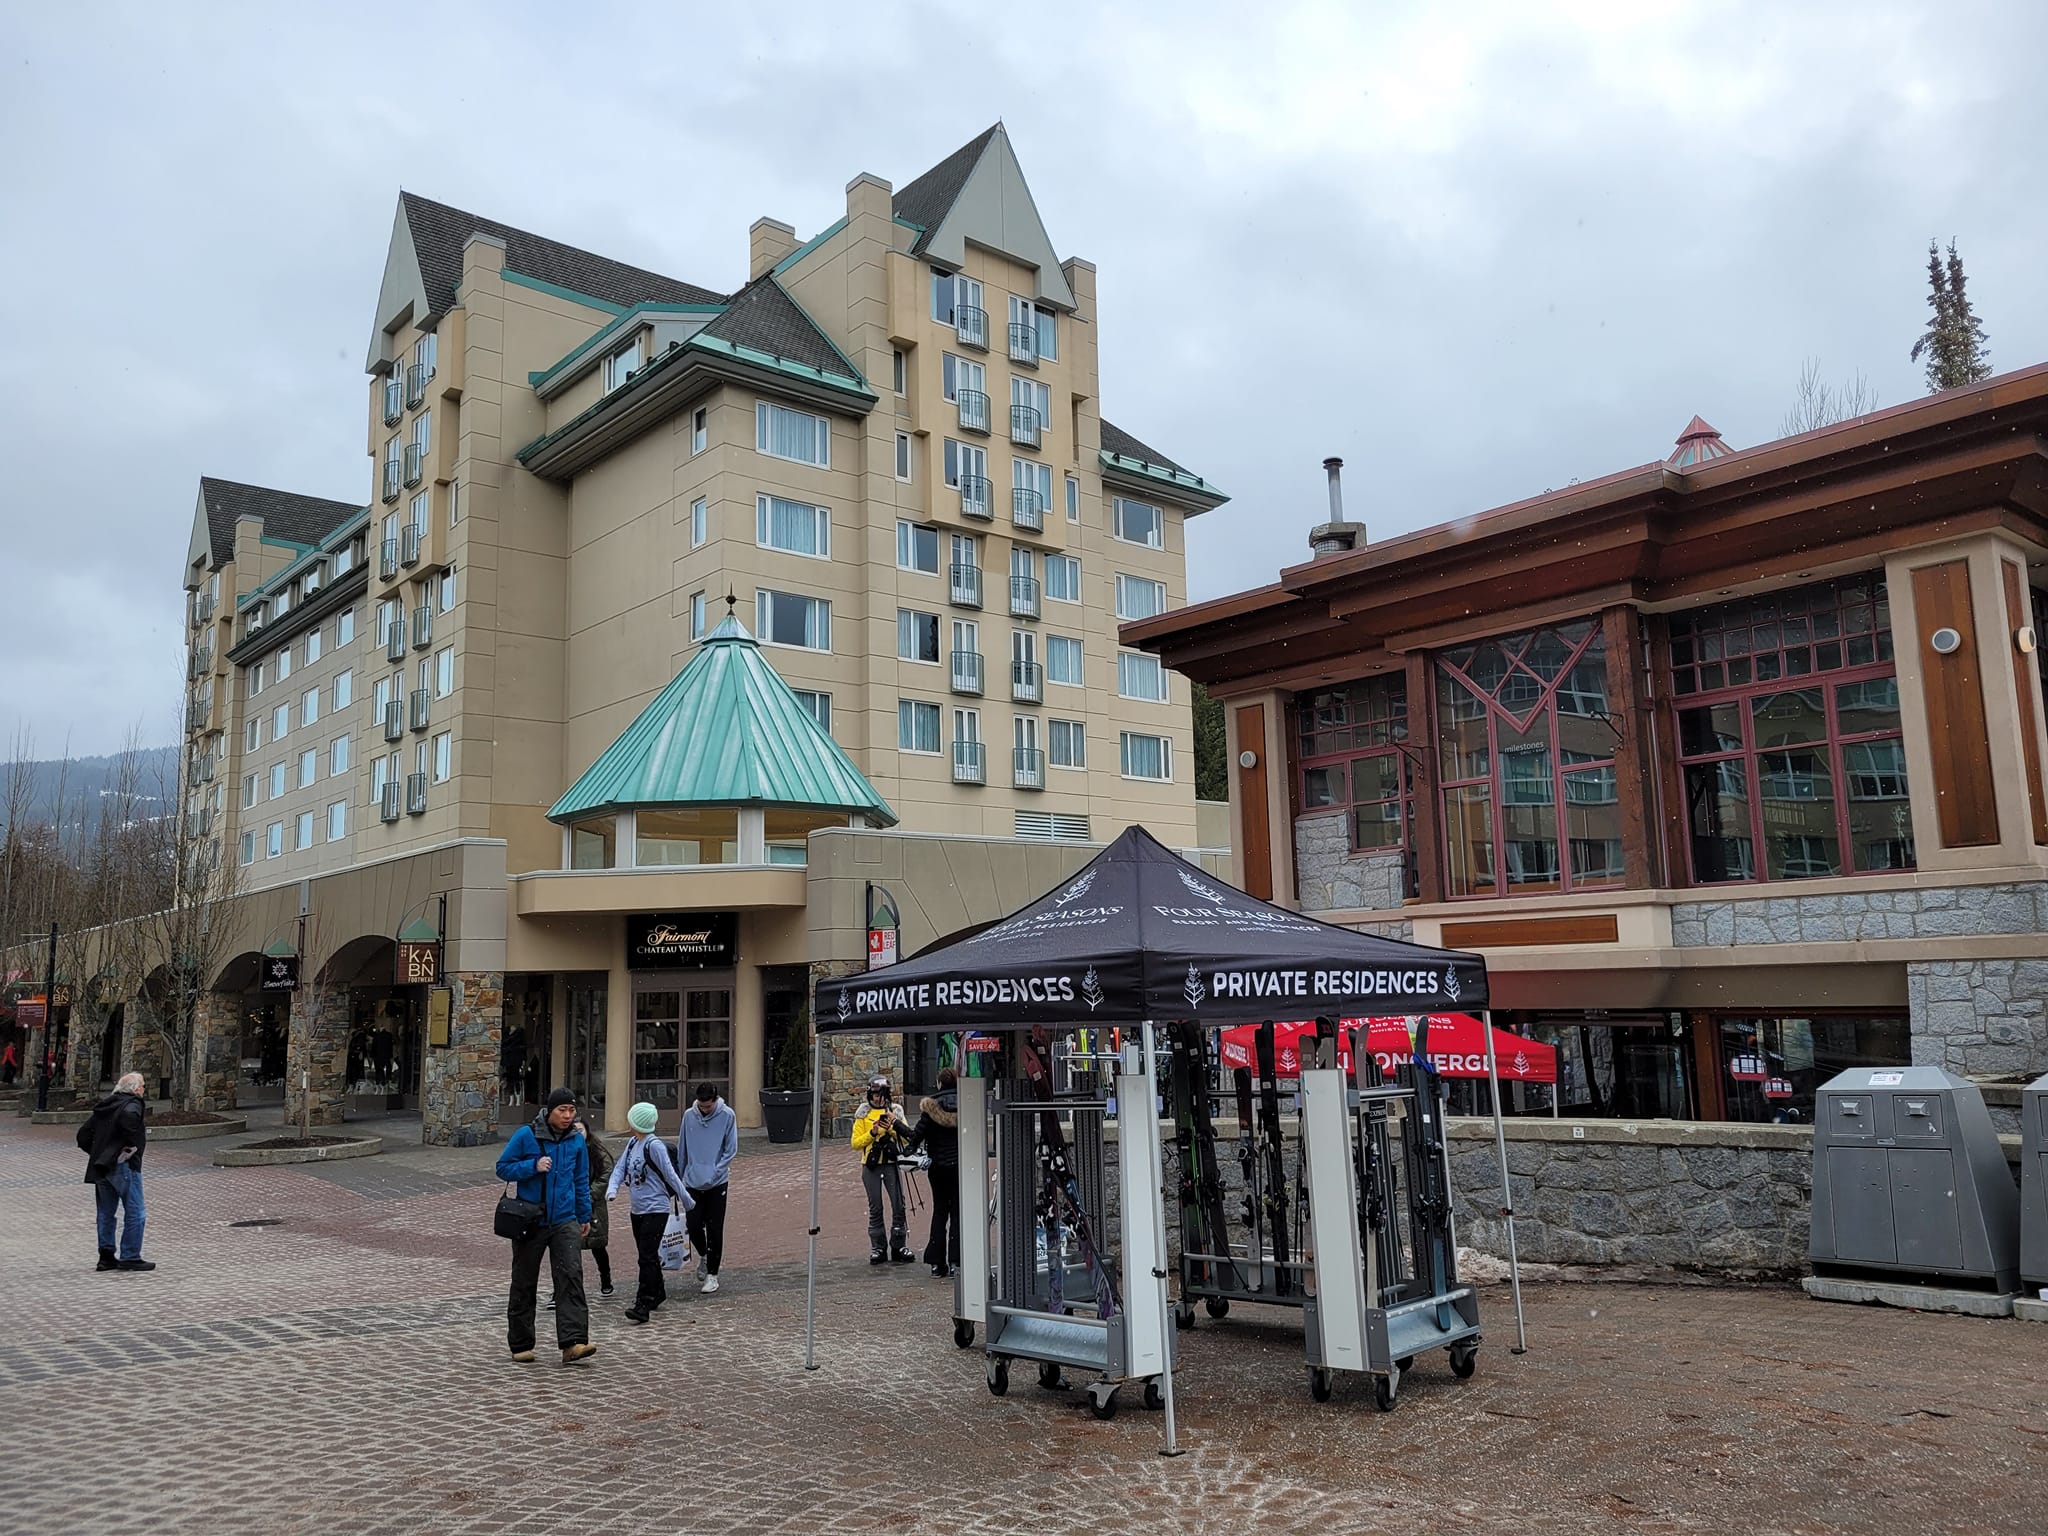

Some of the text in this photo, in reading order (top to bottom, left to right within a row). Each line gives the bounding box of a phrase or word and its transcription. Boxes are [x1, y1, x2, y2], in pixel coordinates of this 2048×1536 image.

[1504, 741, 1545, 753] milestones
[1030, 906, 1124, 924] SEASONS
[1152, 905, 1218, 917] FOUR
[1033, 918, 1108, 930] RESIDENCES
[647, 924, 712, 946] Fairmont
[883, 931, 895, 940] RED
[637, 945, 677, 954] CHATEAU
[1213, 971, 1439, 997] PRIVATE RESIDENCES
[856, 976, 1075, 1014] PRIVATE RESIDENCES
